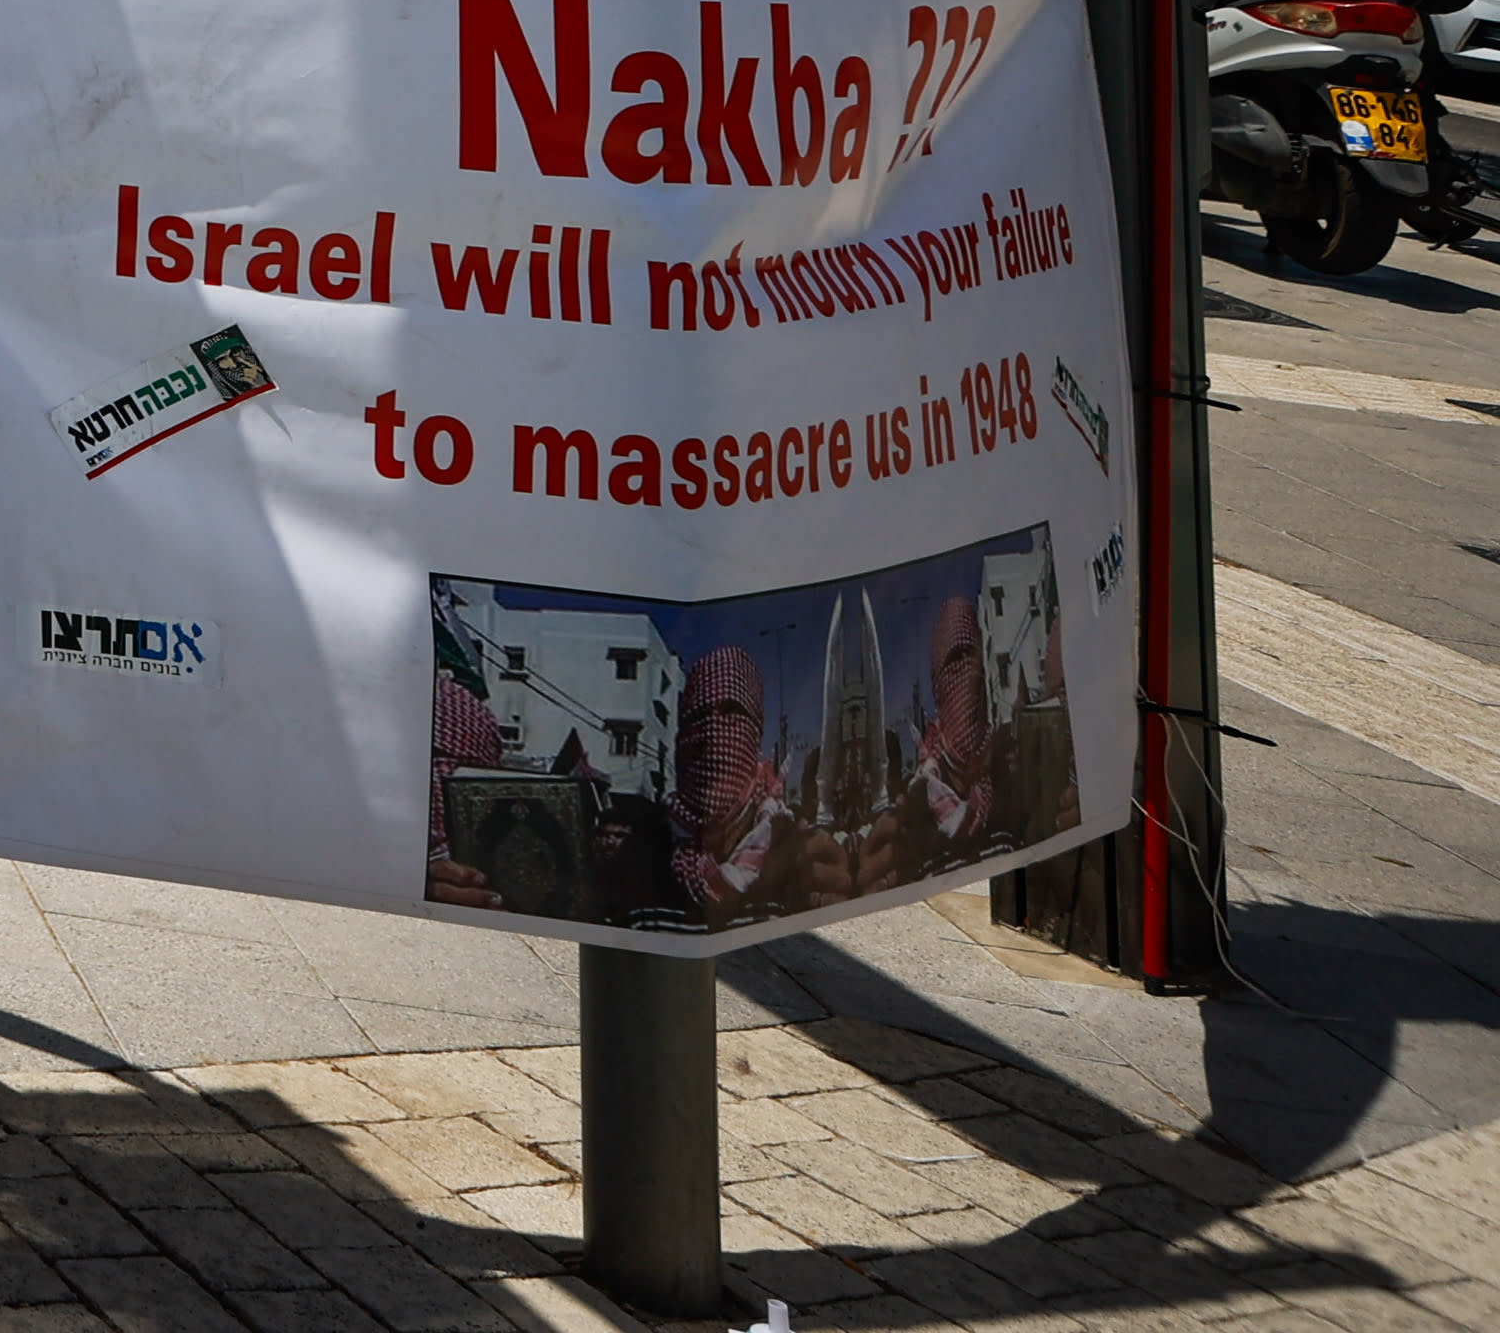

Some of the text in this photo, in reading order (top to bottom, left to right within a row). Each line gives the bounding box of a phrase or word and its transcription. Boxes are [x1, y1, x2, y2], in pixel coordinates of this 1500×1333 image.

[114, 183, 1073, 331] Israel will not mourn your failure
[67, 364, 207, 453] נכבה חרטא
[365, 388, 476, 487] to
[510, 397, 855, 511] massacre
[865, 410, 912, 480] us
[922, 396, 955, 466] in
[960, 350, 1038, 457] 1948
[42, 649, 181, 676] בונים חברה ציונית
